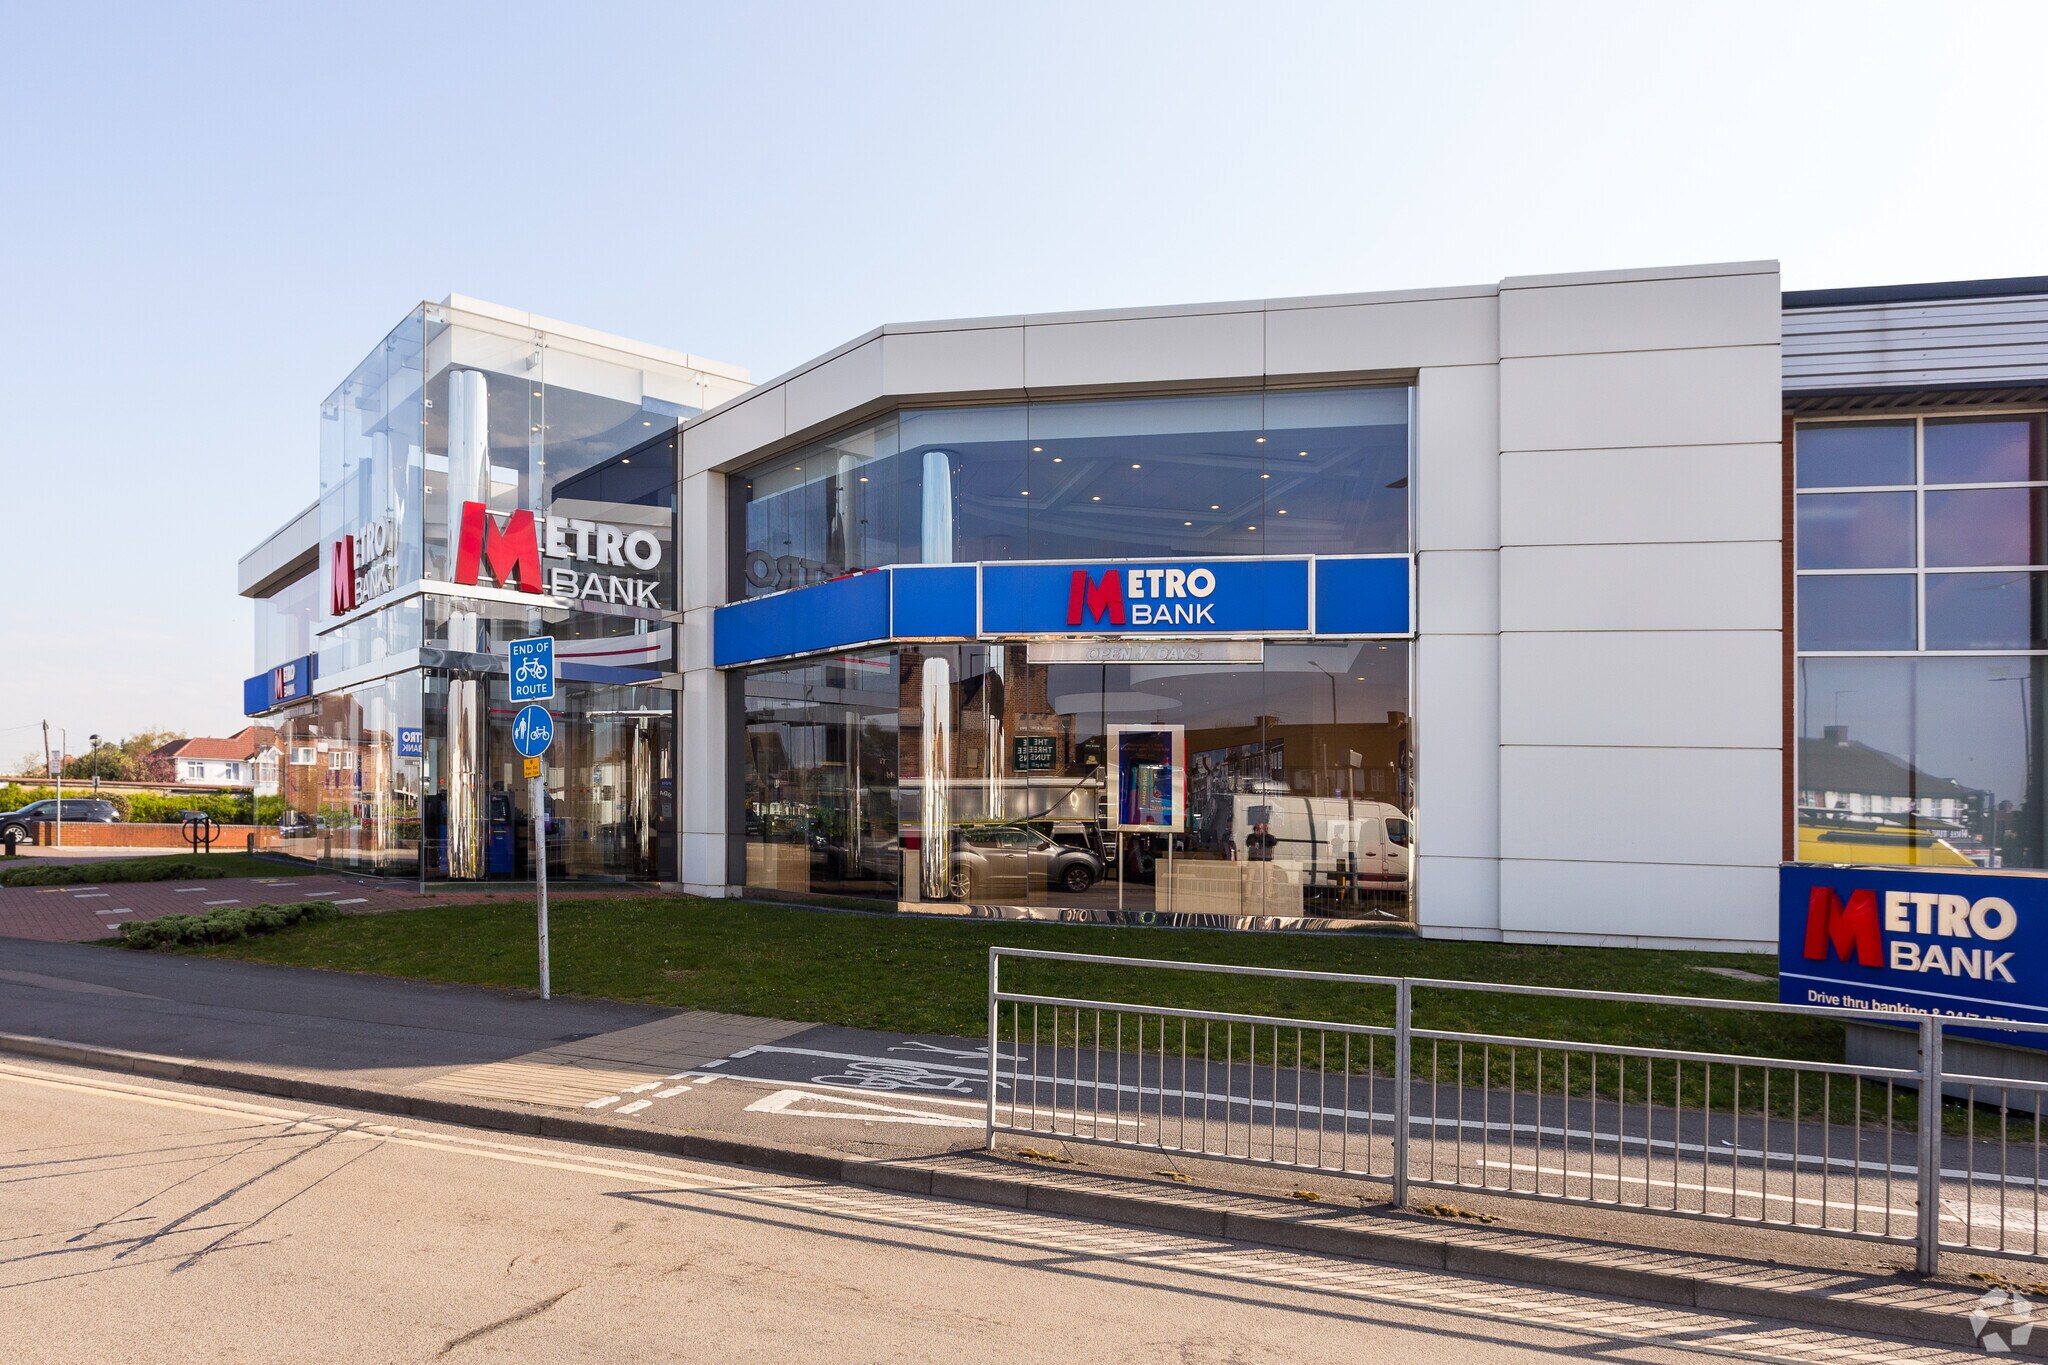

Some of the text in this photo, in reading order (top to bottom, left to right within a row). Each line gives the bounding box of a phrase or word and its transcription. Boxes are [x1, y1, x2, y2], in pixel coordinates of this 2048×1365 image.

[331, 518, 387, 616] METRO
[455, 500, 662, 595] METRO
[354, 564, 389, 606] BANK
[551, 567, 661, 609] BANK
[1067, 568, 1216, 625] METRO
[1132, 603, 1216, 625] BANK
[513, 642, 549, 655] END OF
[1088, 643, 1200, 660] OPEN 7 DAYS
[516, 683, 547, 695] ROUTE
[1804, 886, 2017, 967] METRO
[1890, 941, 2017, 984] BANK
[1807, 990, 1840, 1007] Drive
[1842, 995, 1869, 1011] thru
